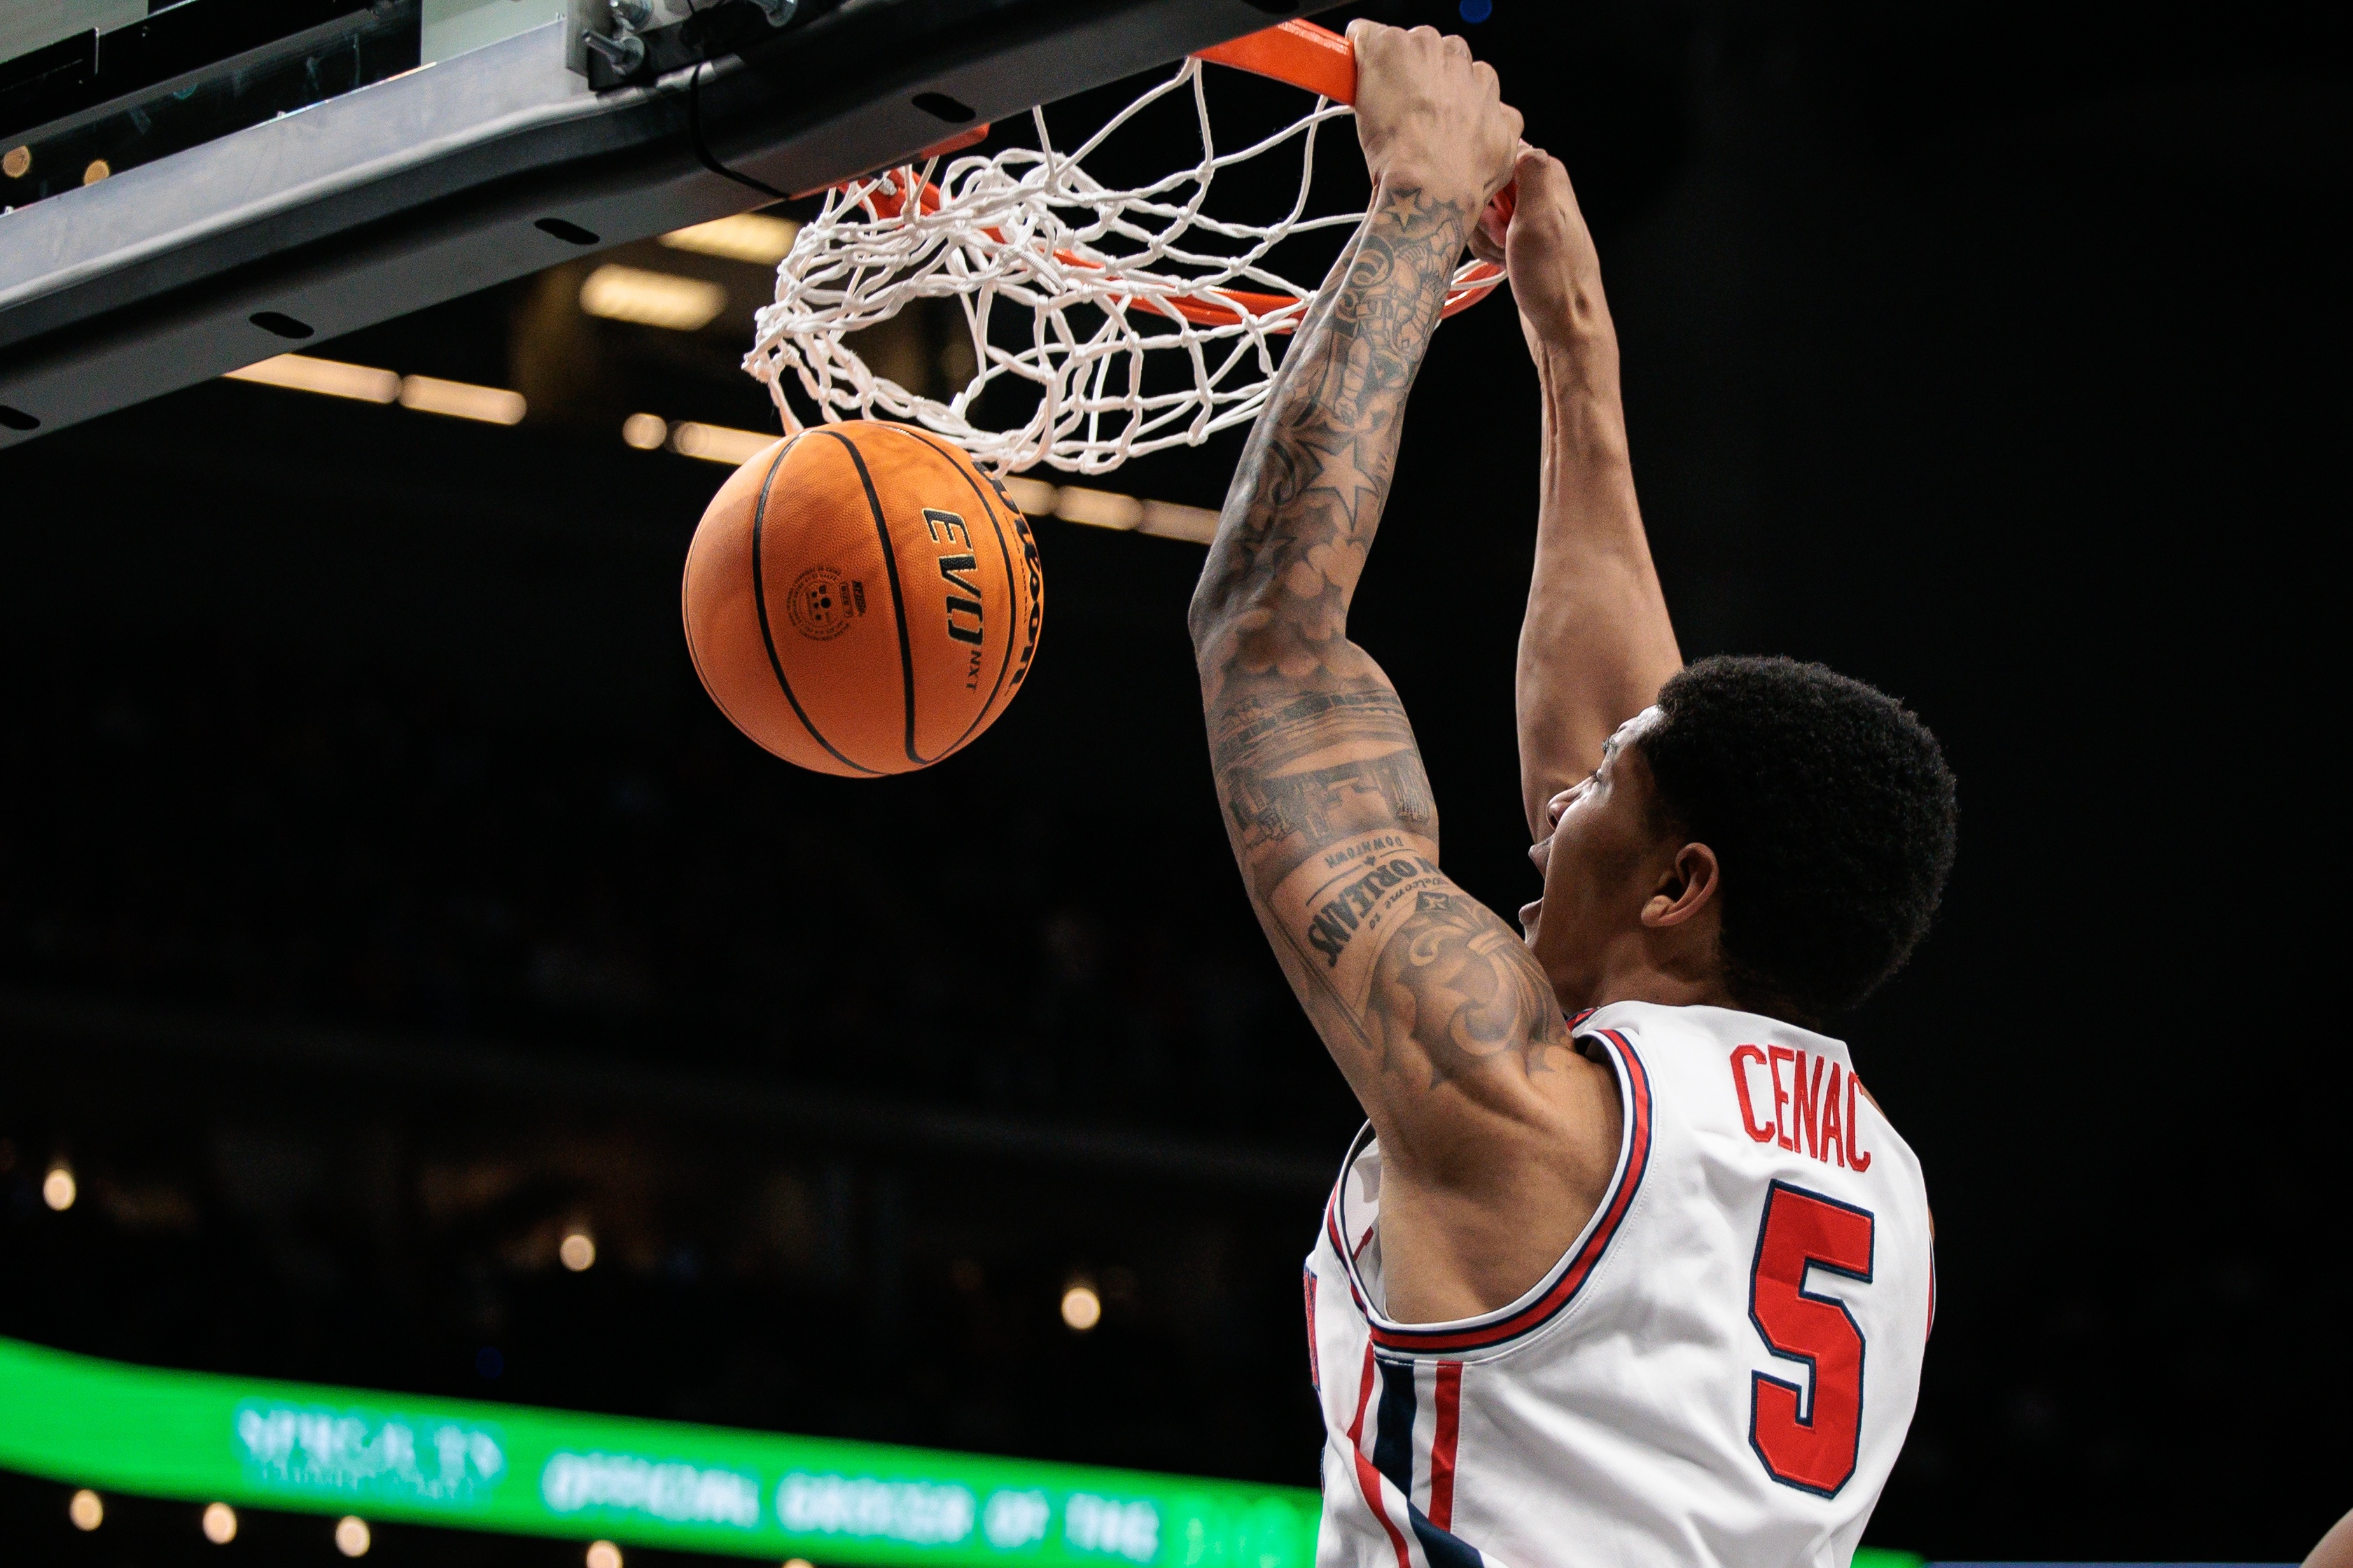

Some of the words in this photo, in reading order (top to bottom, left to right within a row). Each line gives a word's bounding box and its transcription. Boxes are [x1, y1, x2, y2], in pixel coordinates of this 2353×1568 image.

[921, 507, 984, 647] EVO
[966, 650, 982, 694] NXT
[1325, 836, 1404, 869] DOWNTOWN
[1308, 860, 1418, 967] ORLEANS
[1369, 913, 1381, 930] to
[1729, 1044, 1871, 1172] CENAC
[1748, 1178, 1874, 1500] 5
